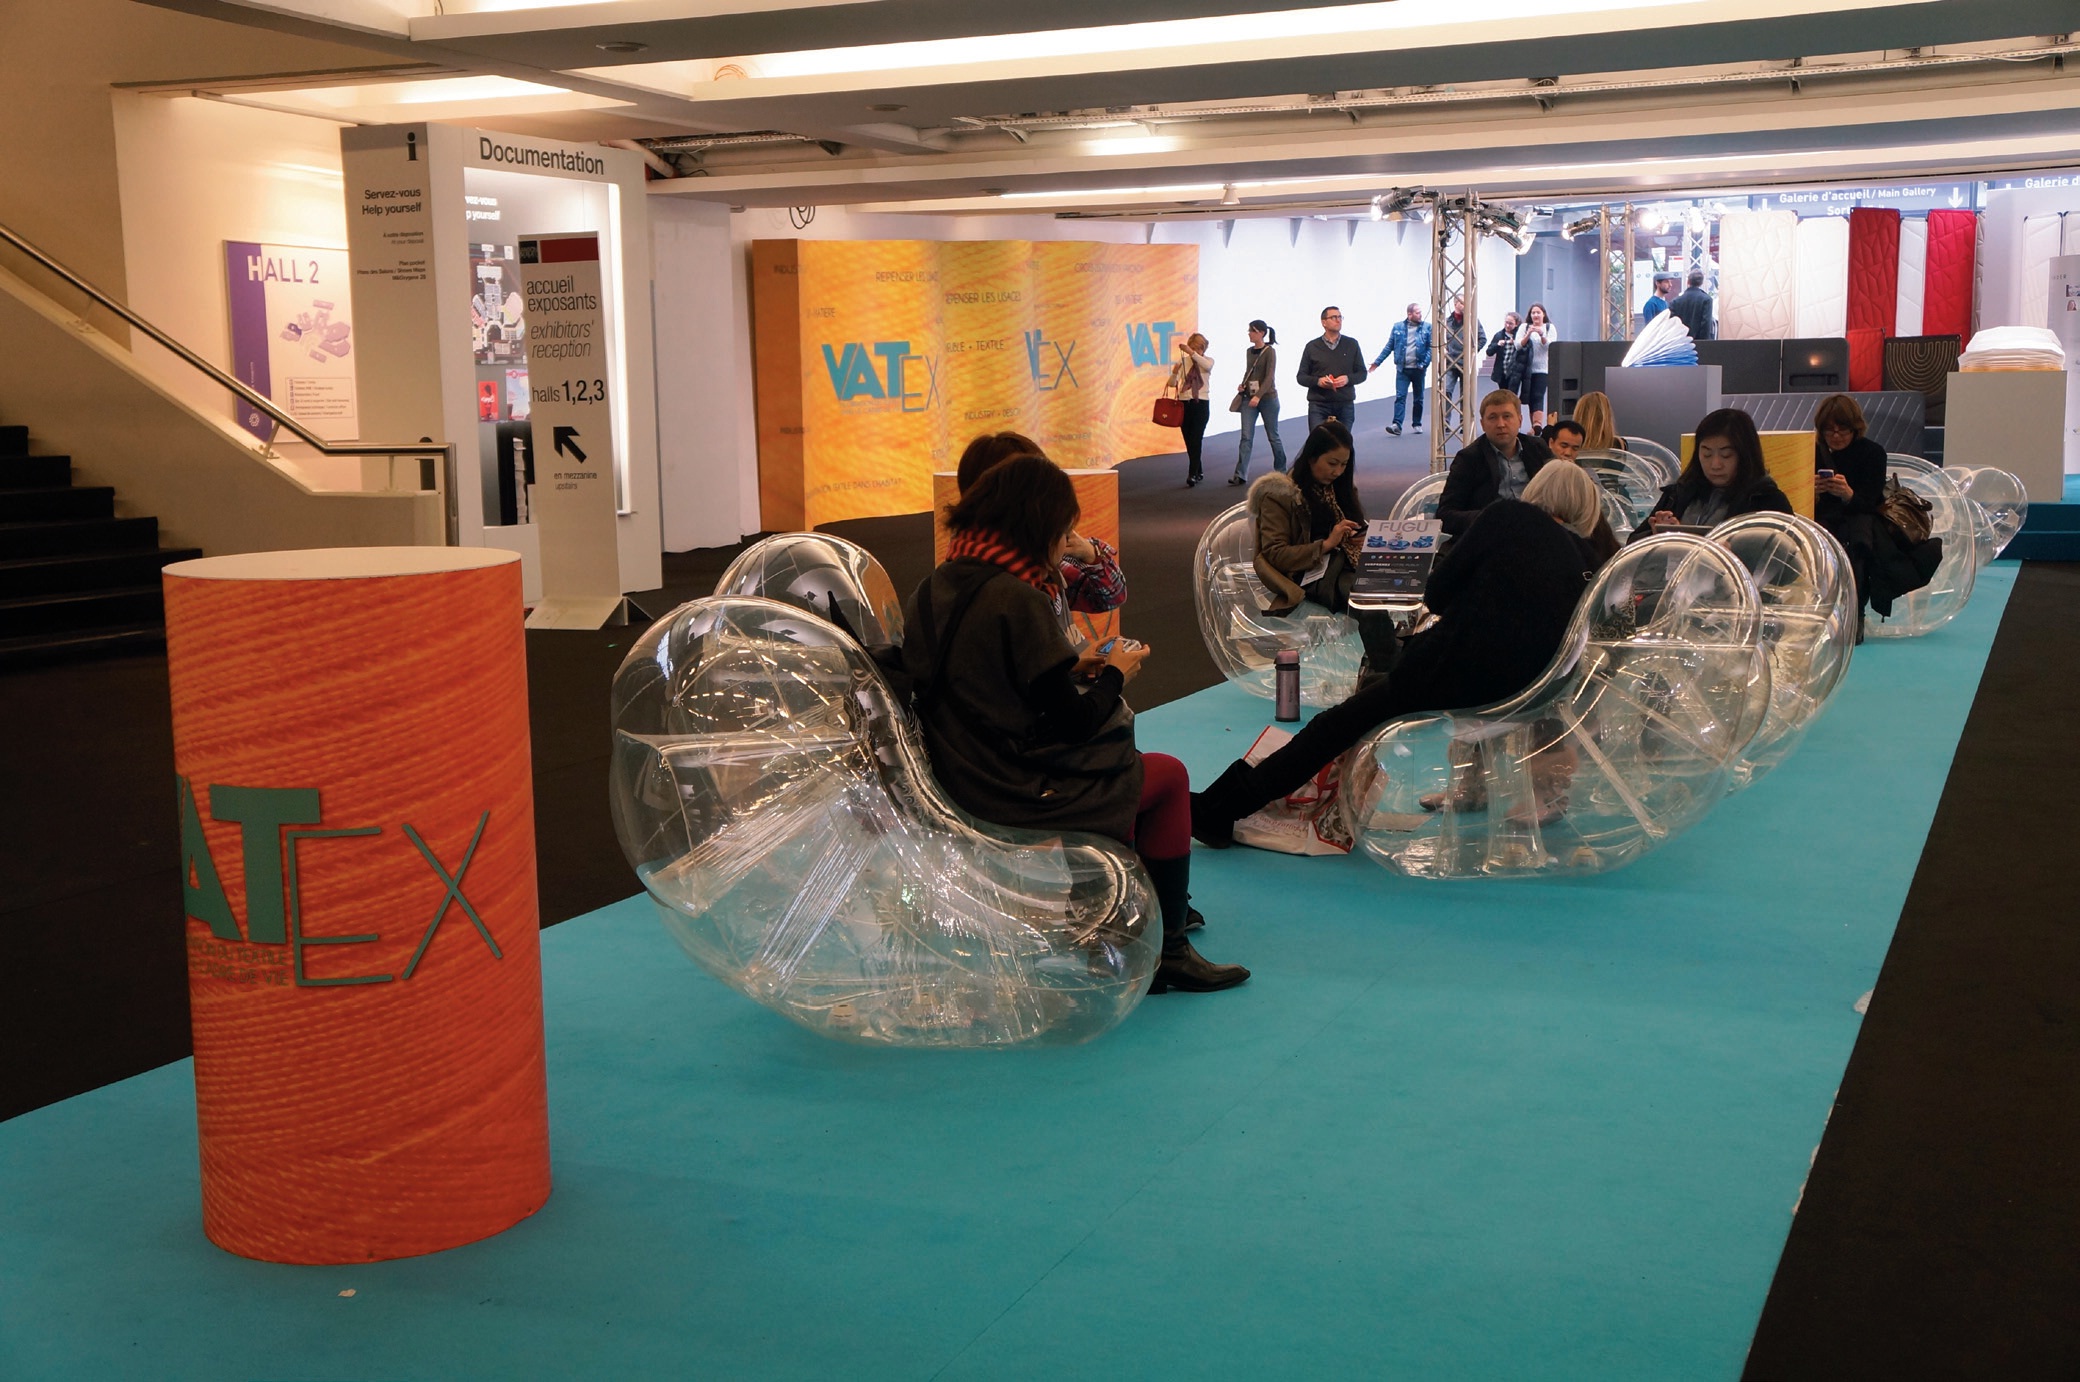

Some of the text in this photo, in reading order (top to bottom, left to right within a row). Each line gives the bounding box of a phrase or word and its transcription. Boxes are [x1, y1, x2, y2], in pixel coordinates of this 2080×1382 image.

[479, 136, 605, 176] Documentation
[2024, 176, 2069, 188] Galerie
[364, 188, 422, 200] Servez-vous
[1779, 191, 1819, 204] Galerie
[1821, 189, 1870, 201] d'accueil
[1877, 188, 1900, 199] Main
[1902, 187, 1937, 198] Gallery
[361, 202, 422, 216] Help yourself
[472, 210, 501, 221] yourself
[247, 255, 320, 284] HALL 2
[526, 276, 574, 295] accueil
[528, 294, 597, 316] exposants
[981, 291, 997, 303] LES
[530, 320, 595, 340] exhibitors'
[531, 340, 591, 361] reception
[976, 339, 1004, 351] TEXTILE
[821, 340, 941, 412] VATEX
[532, 379, 605, 405] halls 1,2,3
[564, 471, 598, 480] mezzanine
[555, 481, 578, 491] upstairs
[1378, 521, 1430, 533] FUGU
[176, 774, 504, 987] ATEX
[262, 969, 289, 987] VIE
